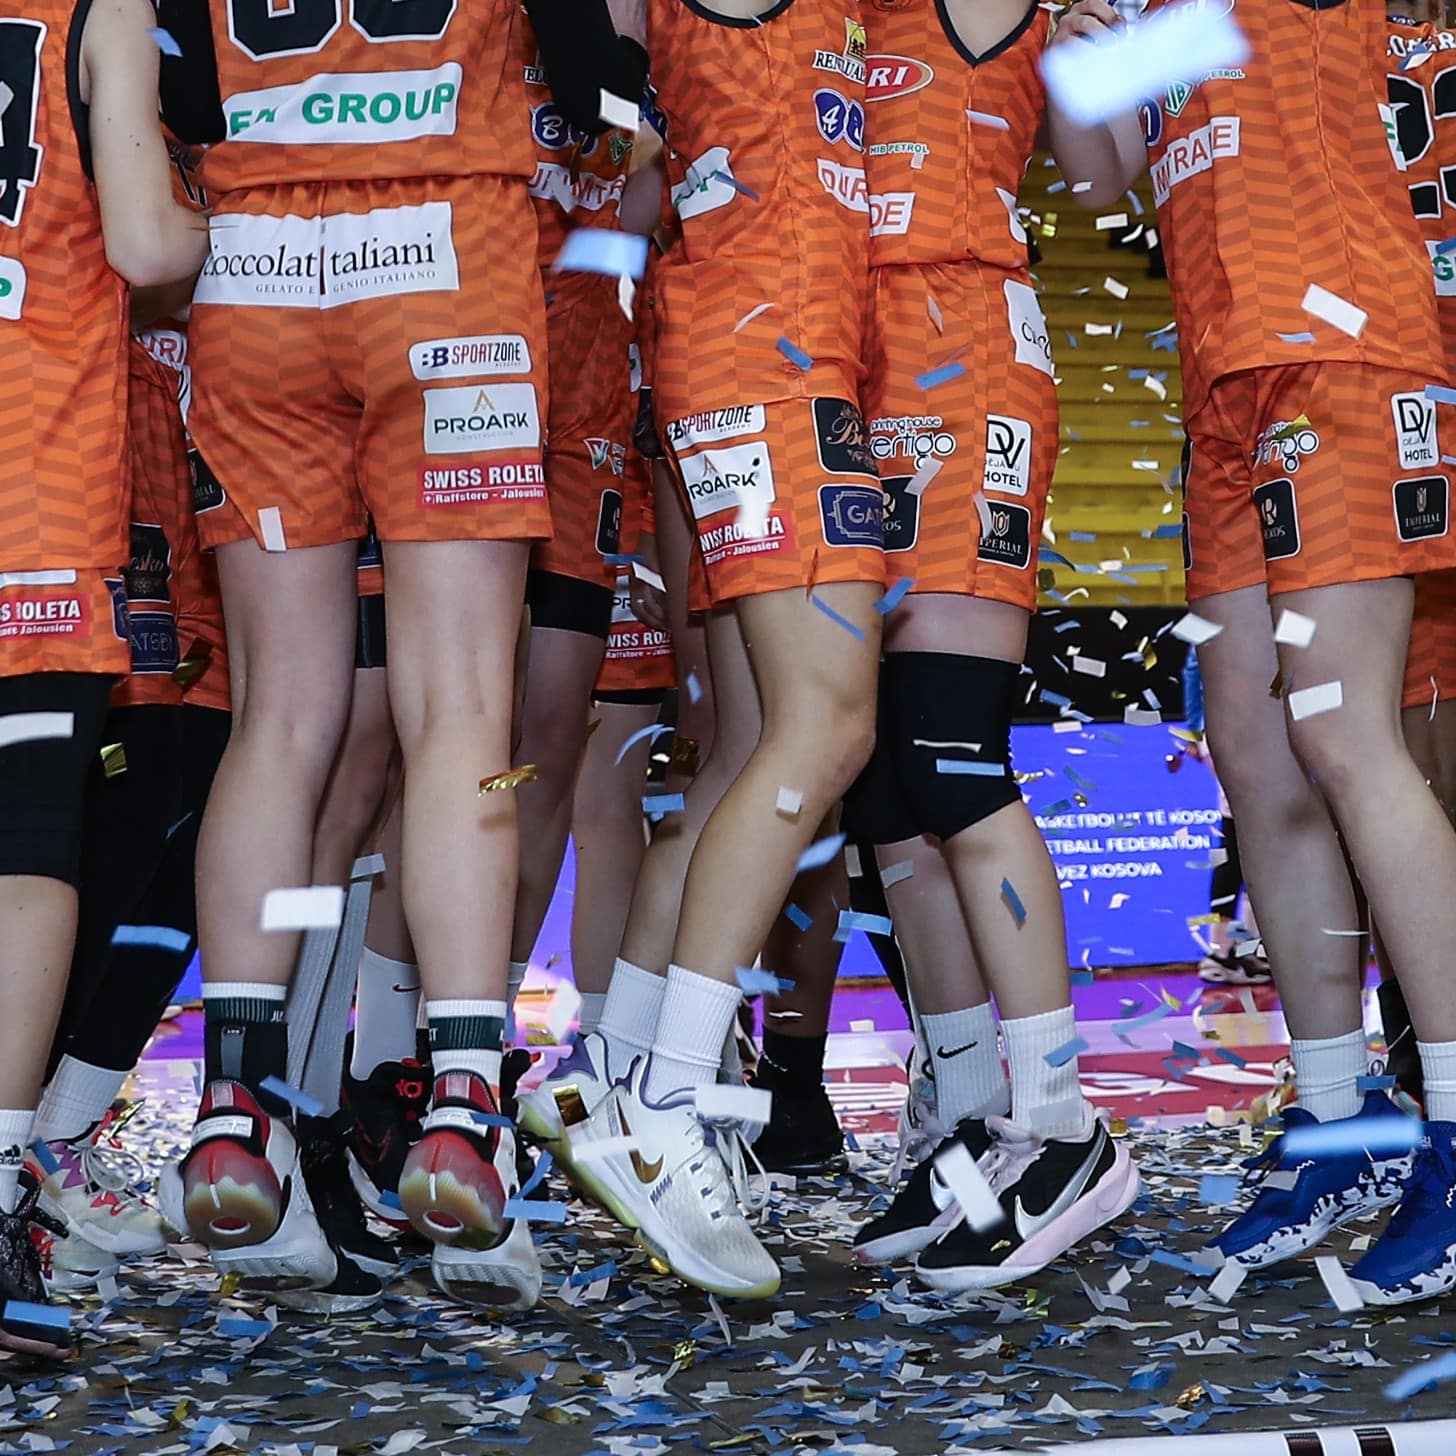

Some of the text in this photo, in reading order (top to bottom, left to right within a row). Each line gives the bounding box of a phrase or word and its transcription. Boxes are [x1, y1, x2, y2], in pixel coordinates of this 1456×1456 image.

[302, 83, 456, 125] GROUP
[255, 283, 300, 294] GELATO
[373, 270, 436, 286] ITALIANO
[451, 341, 522, 365] SPORTZONE
[433, 411, 529, 435] PROARK
[424, 467, 483, 489] SWISS
[1107, 834, 1211, 854] FEDERATION
[1090, 861, 1163, 879] KOSOVA
